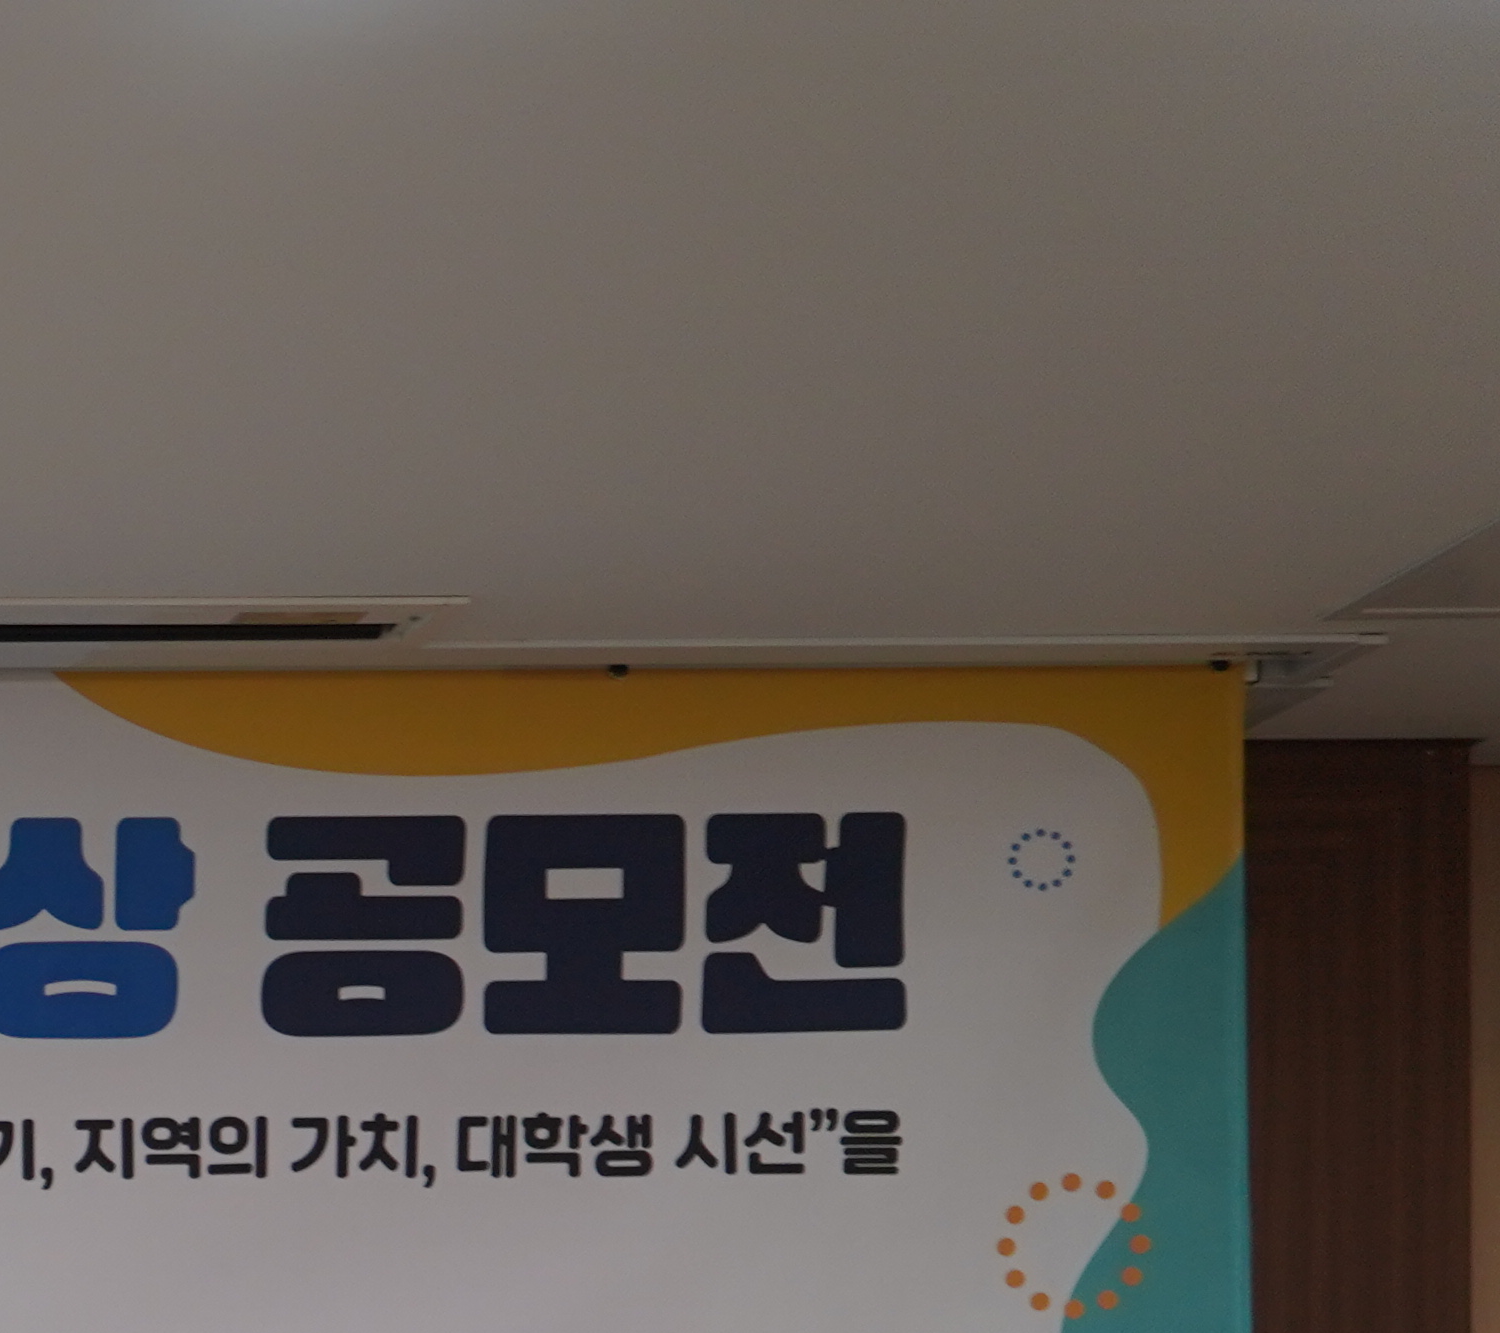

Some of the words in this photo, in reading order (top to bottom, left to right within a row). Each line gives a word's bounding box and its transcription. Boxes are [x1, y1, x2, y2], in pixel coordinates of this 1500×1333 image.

[260, 811, 908, 1038] 공모전
[74, 1115, 269, 1180] 지역의
[290, 1112, 436, 1189] 가치,
[456, 1111, 654, 1179] 대학생
[674, 1107, 903, 1176] 시선”을
